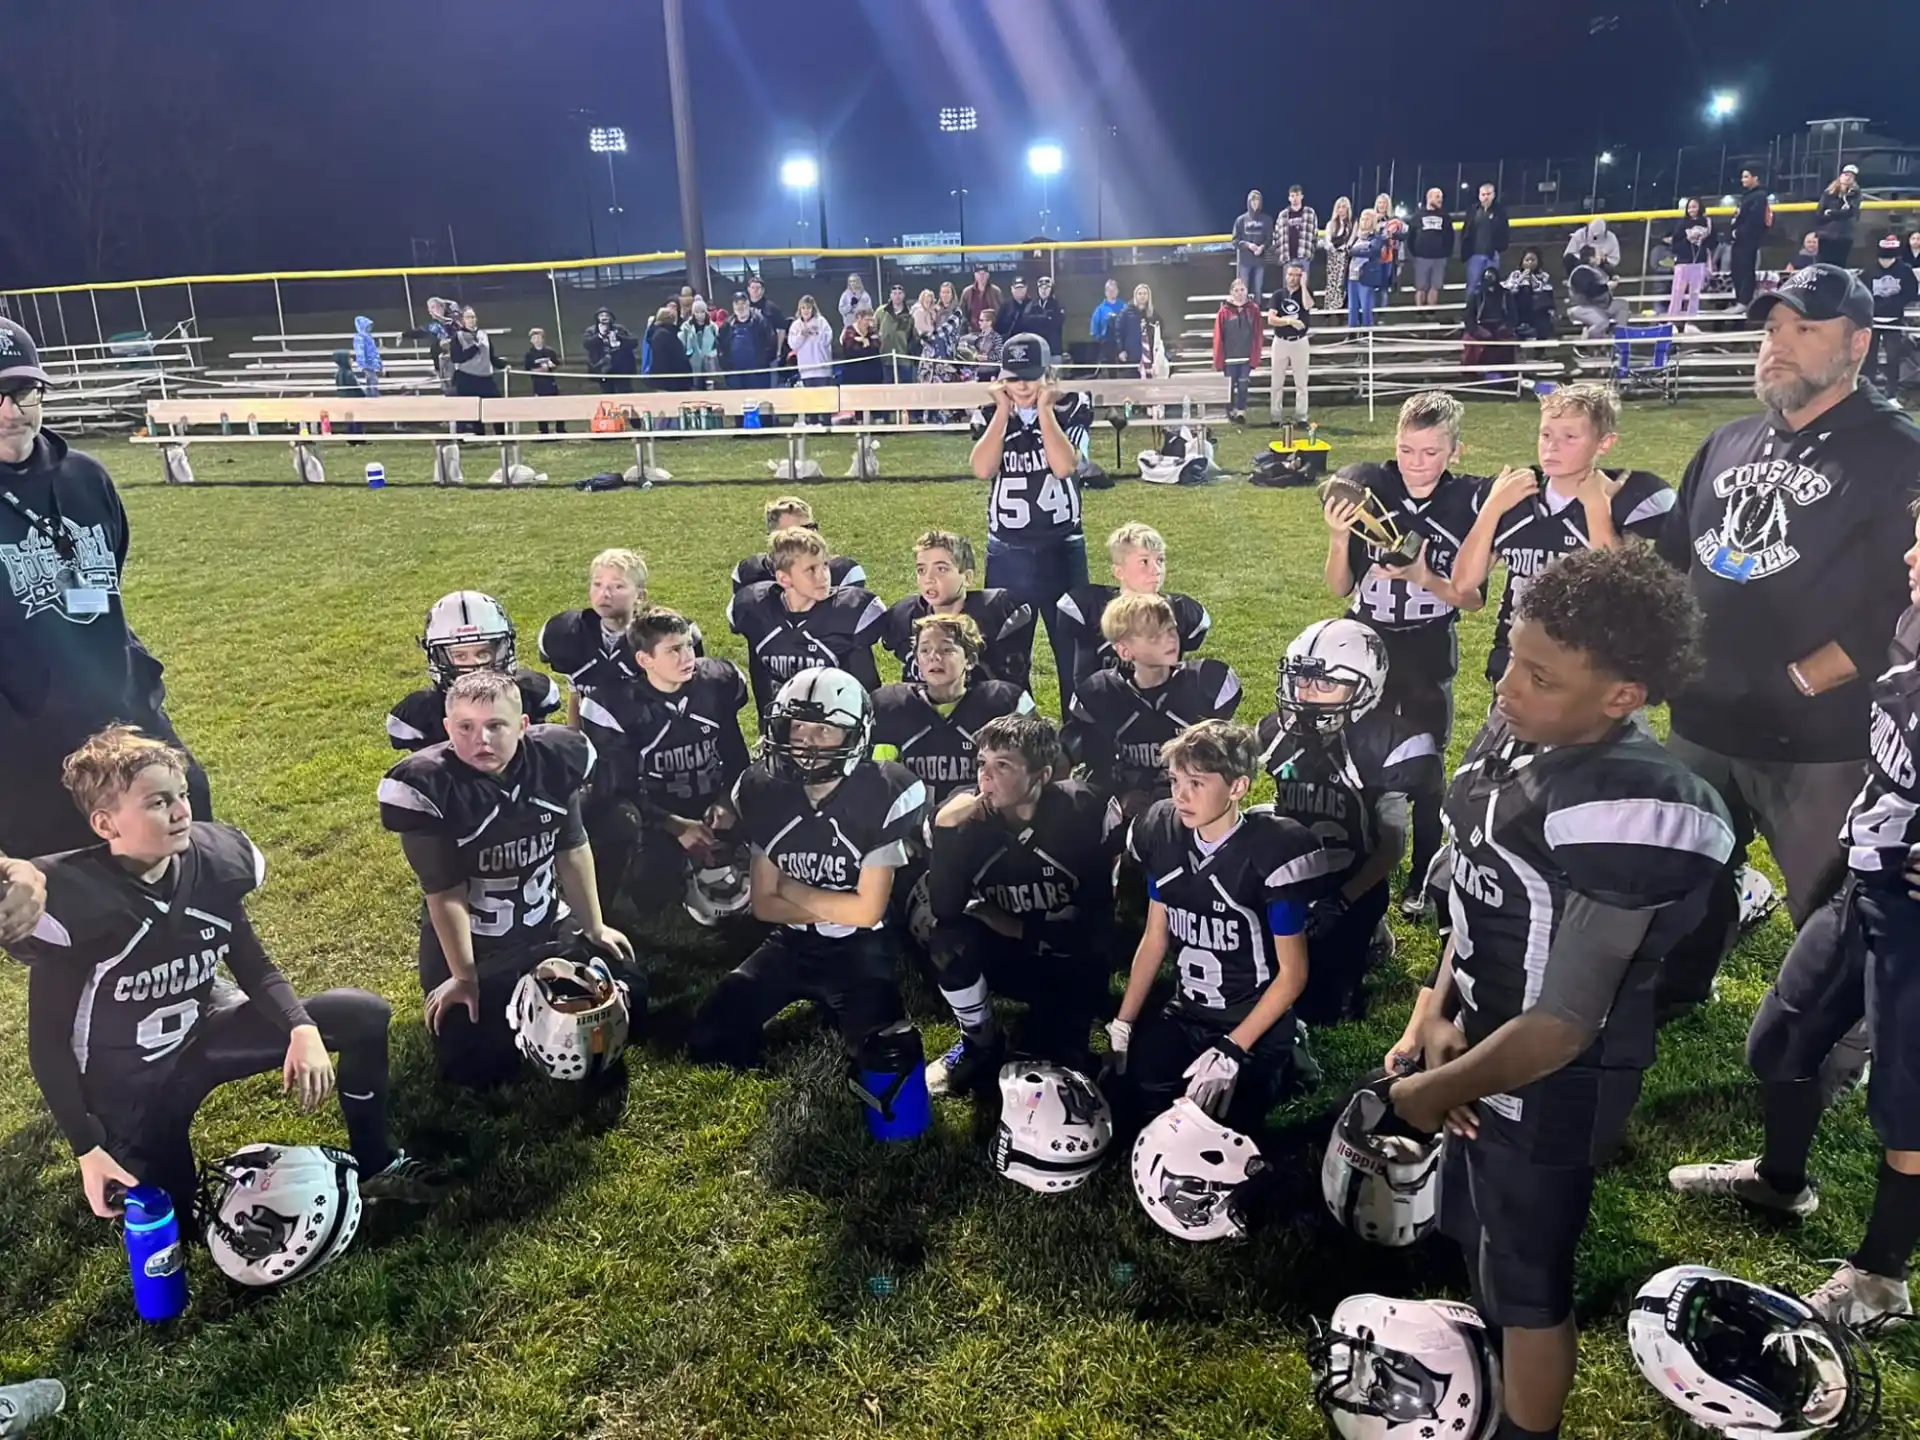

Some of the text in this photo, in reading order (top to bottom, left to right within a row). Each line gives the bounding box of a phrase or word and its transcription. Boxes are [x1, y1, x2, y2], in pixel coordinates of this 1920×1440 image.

[1003, 450, 1049, 473] COUGAR
[1713, 460, 1831, 505] COUGARS
[998, 474, 1070, 529] 54
[0, 524, 116, 596] FOOALL
[1502, 548, 1568, 578] COUGA
[1695, 529, 1799, 578] FOALL
[1360, 563, 1454, 623] 48
[1121, 742, 1170, 768] COUG
[777, 852, 846, 882] COUGARS
[468, 854, 554, 936] 59
[1167, 906, 1239, 951] OUGARS
[1177, 945, 1226, 1009] 8
[136, 998, 200, 1062] 9
